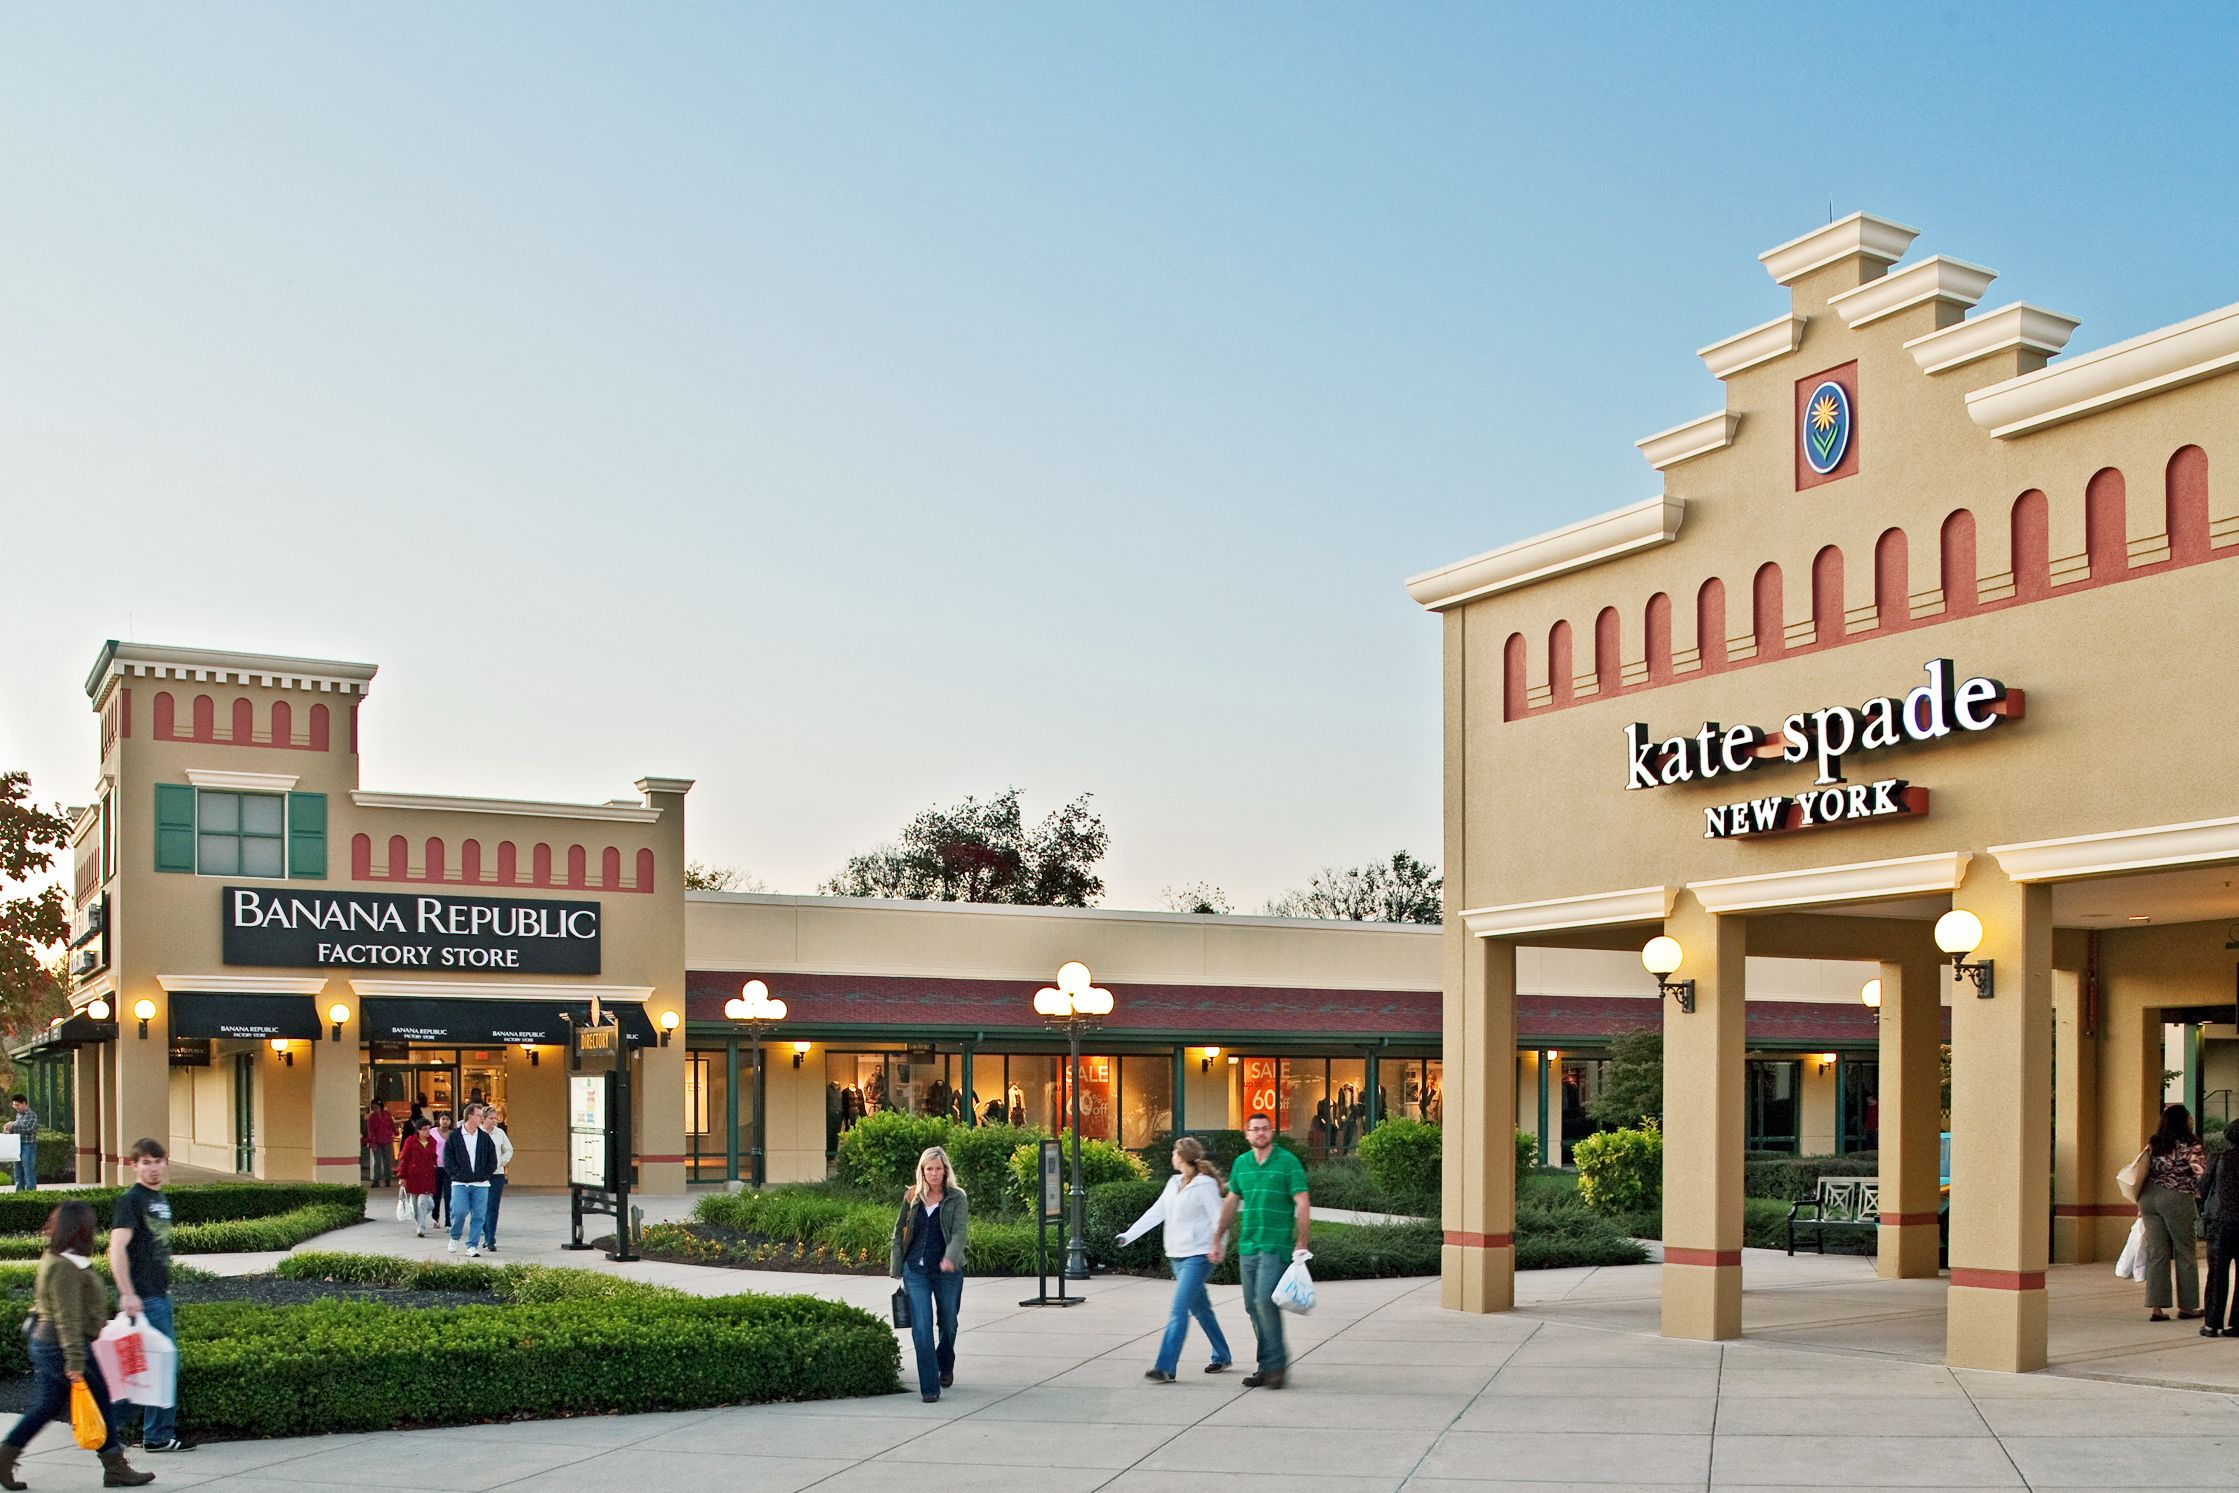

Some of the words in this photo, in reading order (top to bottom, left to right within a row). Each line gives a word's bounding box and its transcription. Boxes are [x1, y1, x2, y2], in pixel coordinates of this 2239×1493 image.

[1623, 722, 1757, 791] kate
[1781, 657, 1999, 786] spade
[1702, 797, 1784, 839] NEW
[1795, 778, 1901, 826] YORK
[234, 890, 407, 933] BANANA
[417, 897, 596, 939] REPUBLIC
[318, 943, 433, 966] FACTORY
[441, 947, 520, 968] STORE
[220, 1025, 250, 1033] BANANA
[250, 1026, 280, 1034] REPUBLIC
[391, 1026, 419, 1035] BANANA
[419, 1028, 448, 1036] REPUBLIC
[492, 1030, 519, 1038] BANANA
[518, 1031, 546, 1039] REPUBLIC
[580, 1031, 609, 1050] DIRECTORY
